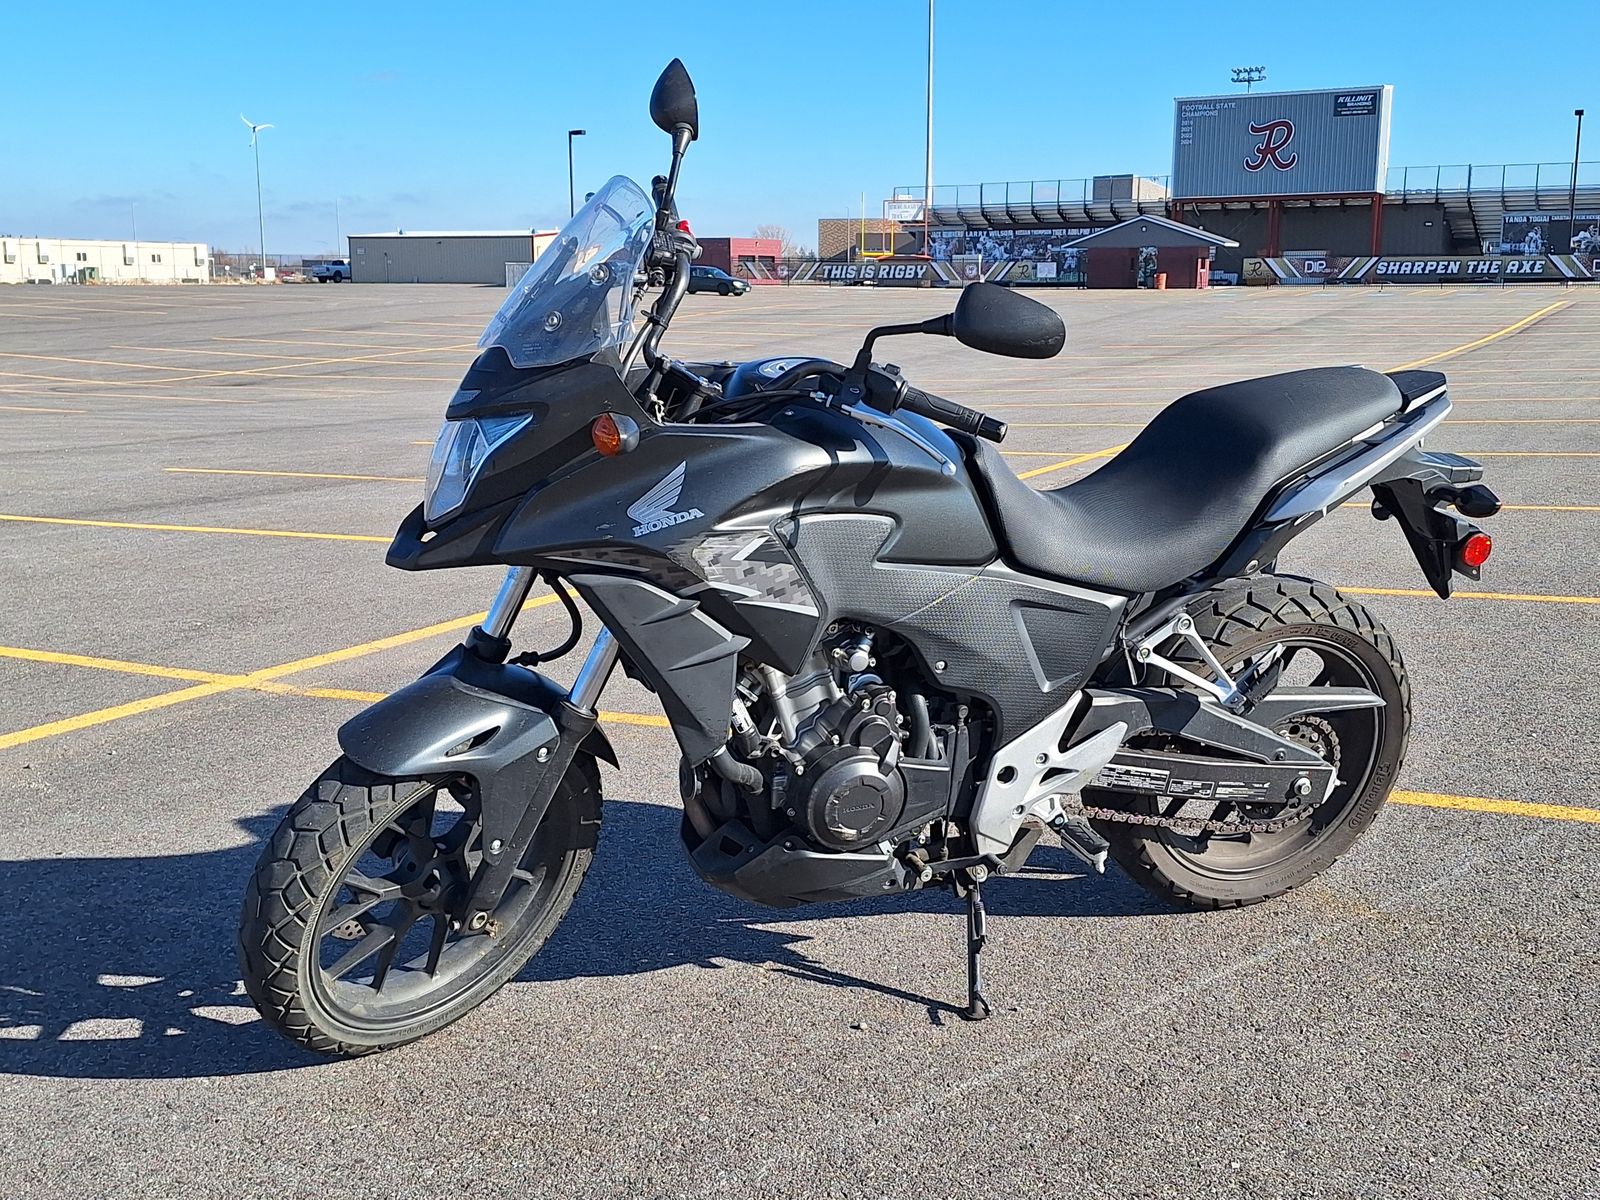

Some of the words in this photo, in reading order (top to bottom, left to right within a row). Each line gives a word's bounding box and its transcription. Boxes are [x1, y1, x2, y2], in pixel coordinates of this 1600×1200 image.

[989, 230, 1013, 238] WILSON
[823, 265, 857, 279] THIS
[859, 265, 876, 279] IS
[878, 265, 928, 279] RIGBY
[1376, 261, 1461, 274] SHARPEN
[1467, 260, 1503, 274] THE
[1505, 260, 1546, 274] AXE
[632, 508, 704, 537] HONDA
[841, 803, 876, 814] HONDA
